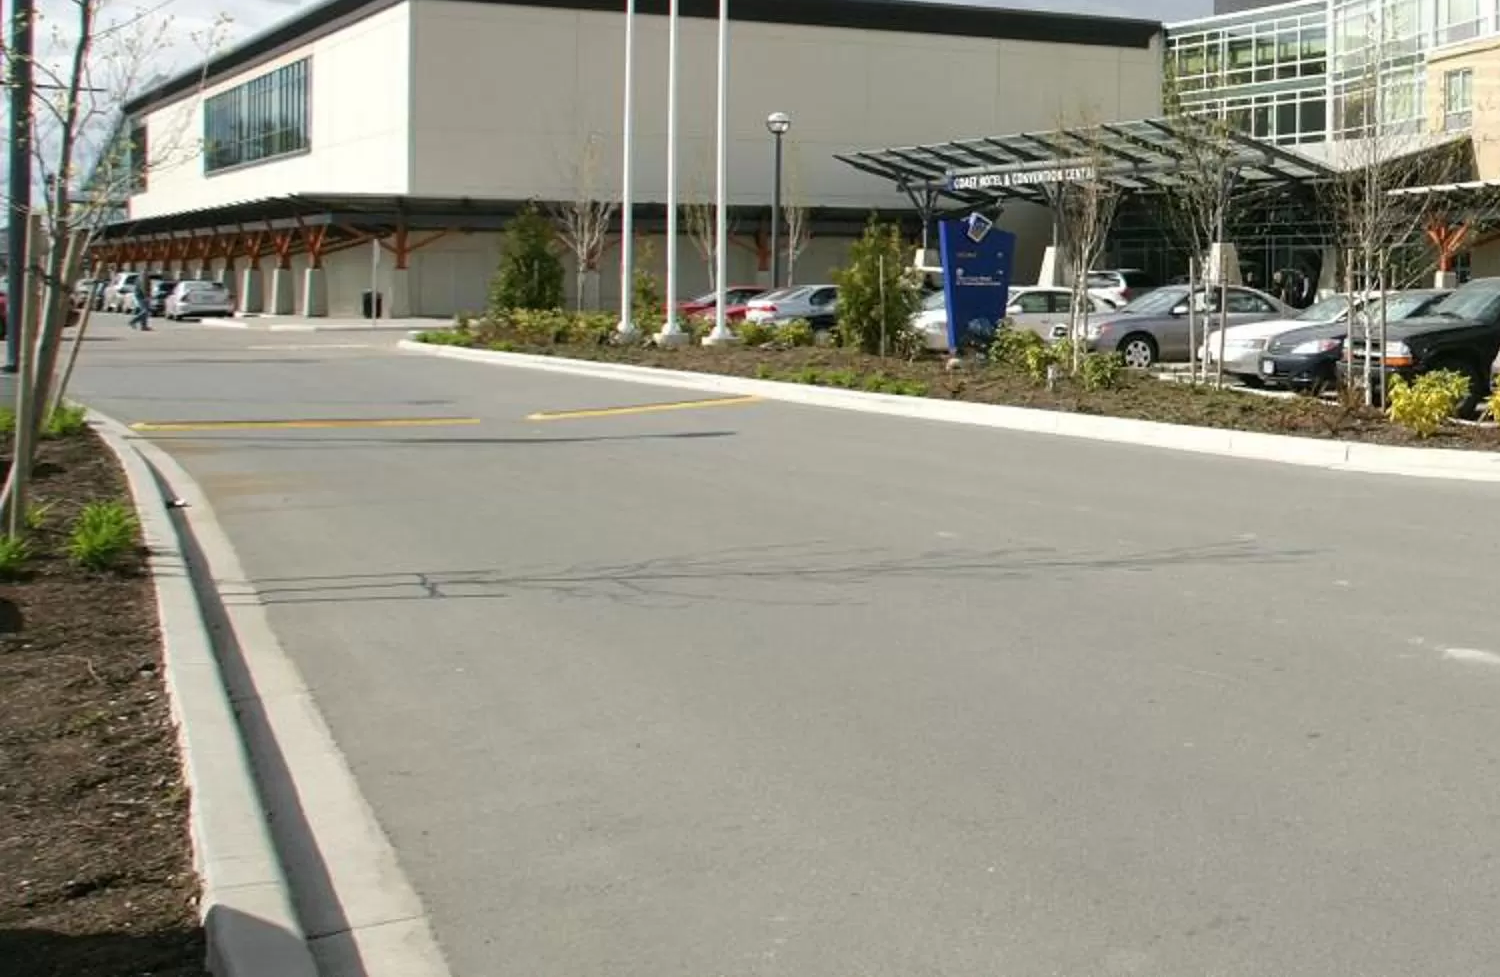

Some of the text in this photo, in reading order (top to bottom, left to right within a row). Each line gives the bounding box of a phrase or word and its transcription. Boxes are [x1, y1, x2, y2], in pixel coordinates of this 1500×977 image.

[953, 176, 977, 189] COAST
[979, 174, 1002, 187] HOTEL
[1012, 170, 1063, 184] CONVENTION
